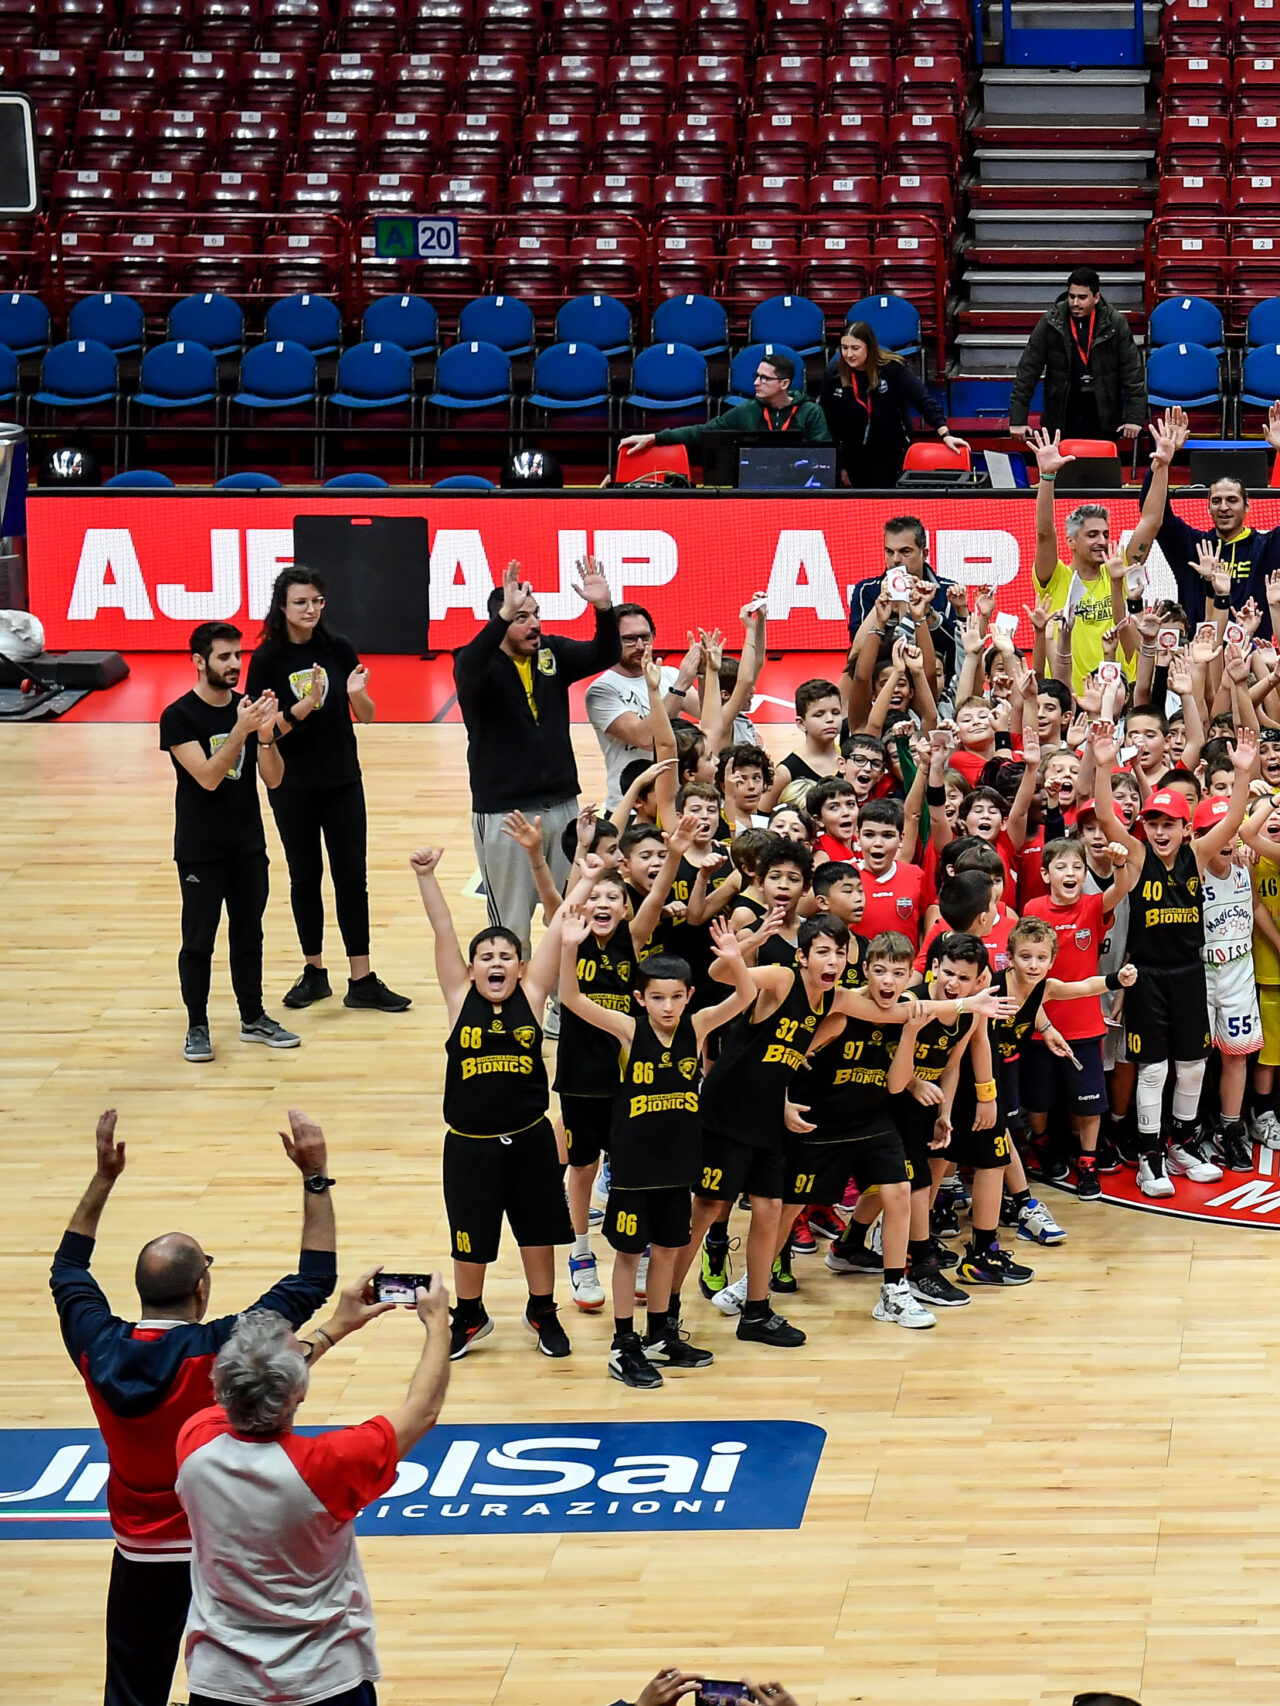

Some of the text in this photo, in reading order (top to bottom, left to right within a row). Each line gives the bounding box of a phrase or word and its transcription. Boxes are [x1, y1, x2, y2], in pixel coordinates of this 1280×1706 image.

[384, 225, 452, 253] A 20
[672, 880, 688, 900] 16
[1142, 881, 1163, 901] 40
[1258, 877, 1278, 898] 46
[1145, 906, 1200, 929] BIONICS
[460, 1026, 482, 1049] 68
[776, 1017, 798, 1043] 32
[1228, 1014, 1252, 1038] 55
[843, 1041, 866, 1060] 97
[461, 1055, 533, 1080] BIONICS
[633, 1061, 654, 1084] 86
[629, 1092, 699, 1118] BIONICS
[701, 1167, 723, 1191] 32
[616, 1211, 637, 1236] 86
[456, 1230, 471, 1253] 68
